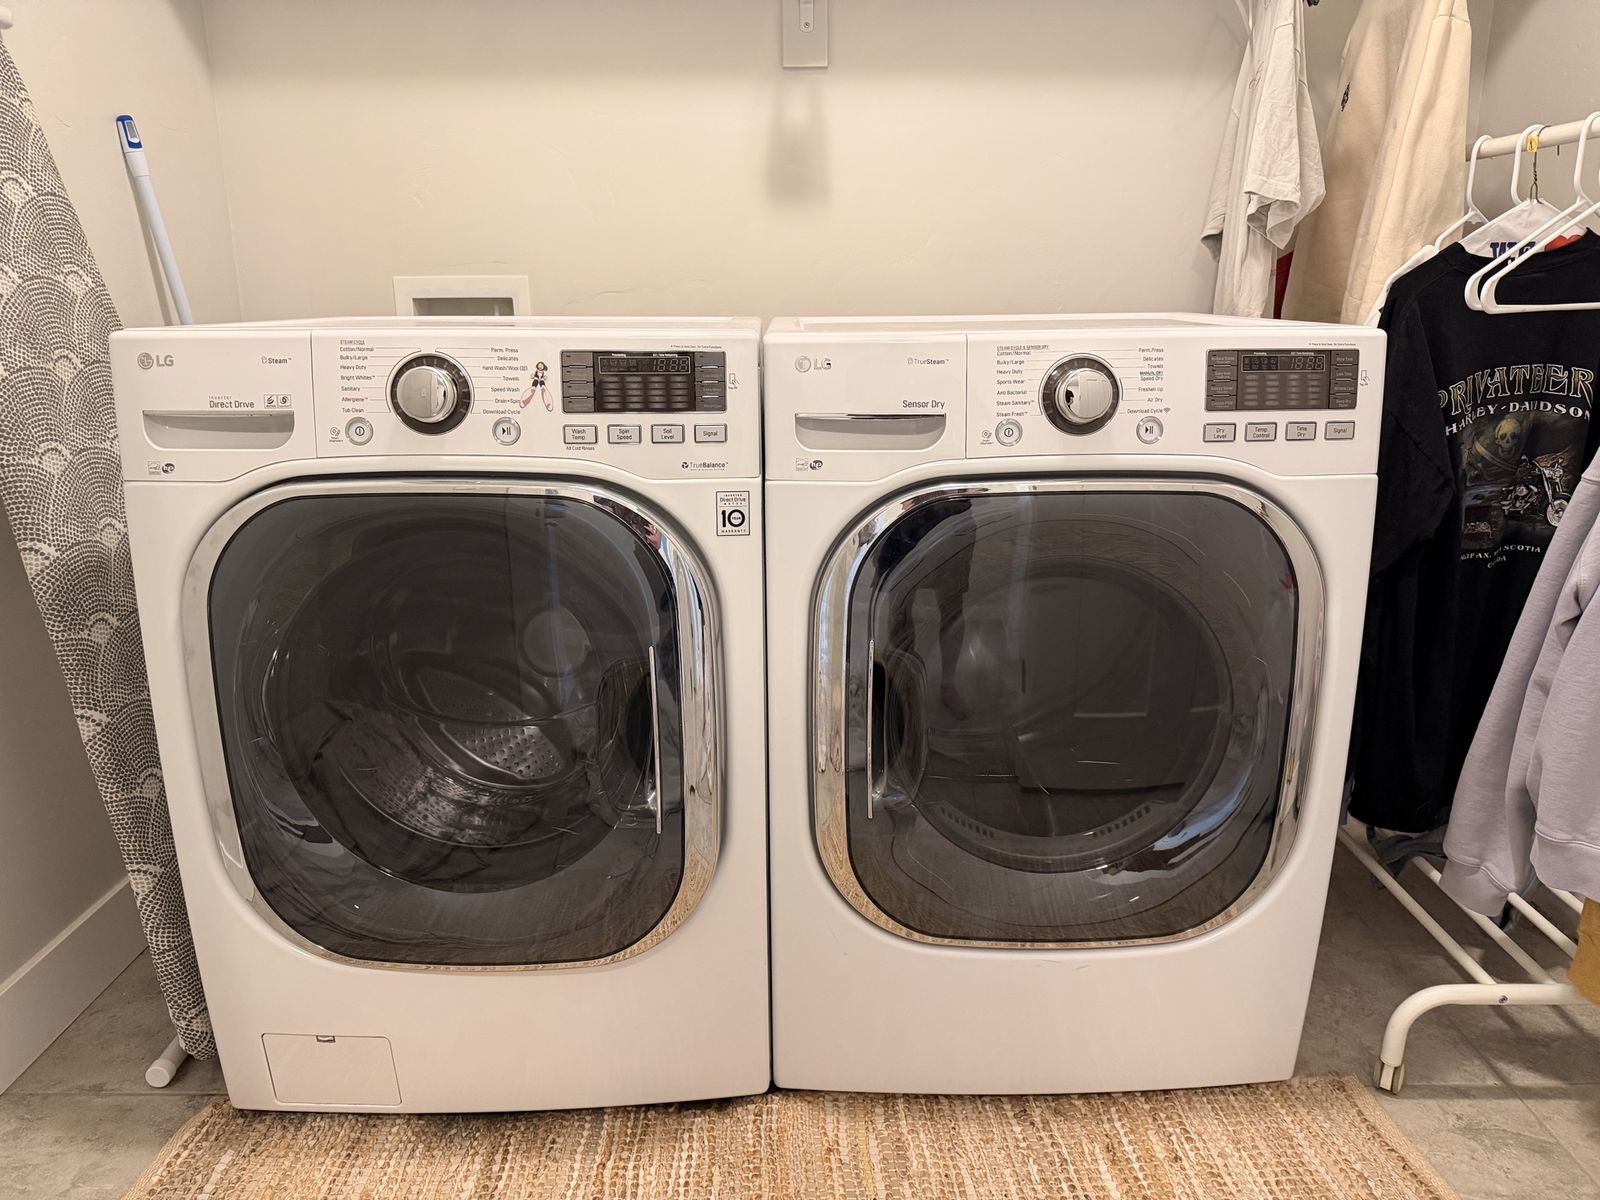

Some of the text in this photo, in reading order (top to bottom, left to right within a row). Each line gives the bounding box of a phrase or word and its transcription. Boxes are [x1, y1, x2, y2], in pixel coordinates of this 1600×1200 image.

[156, 355, 174, 367] LG
[814, 358, 832, 370] LG
[209, 400, 255, 409] Direct Drive
[902, 400, 945, 410] Sensor Dry
[721, 509, 745, 527] 10
